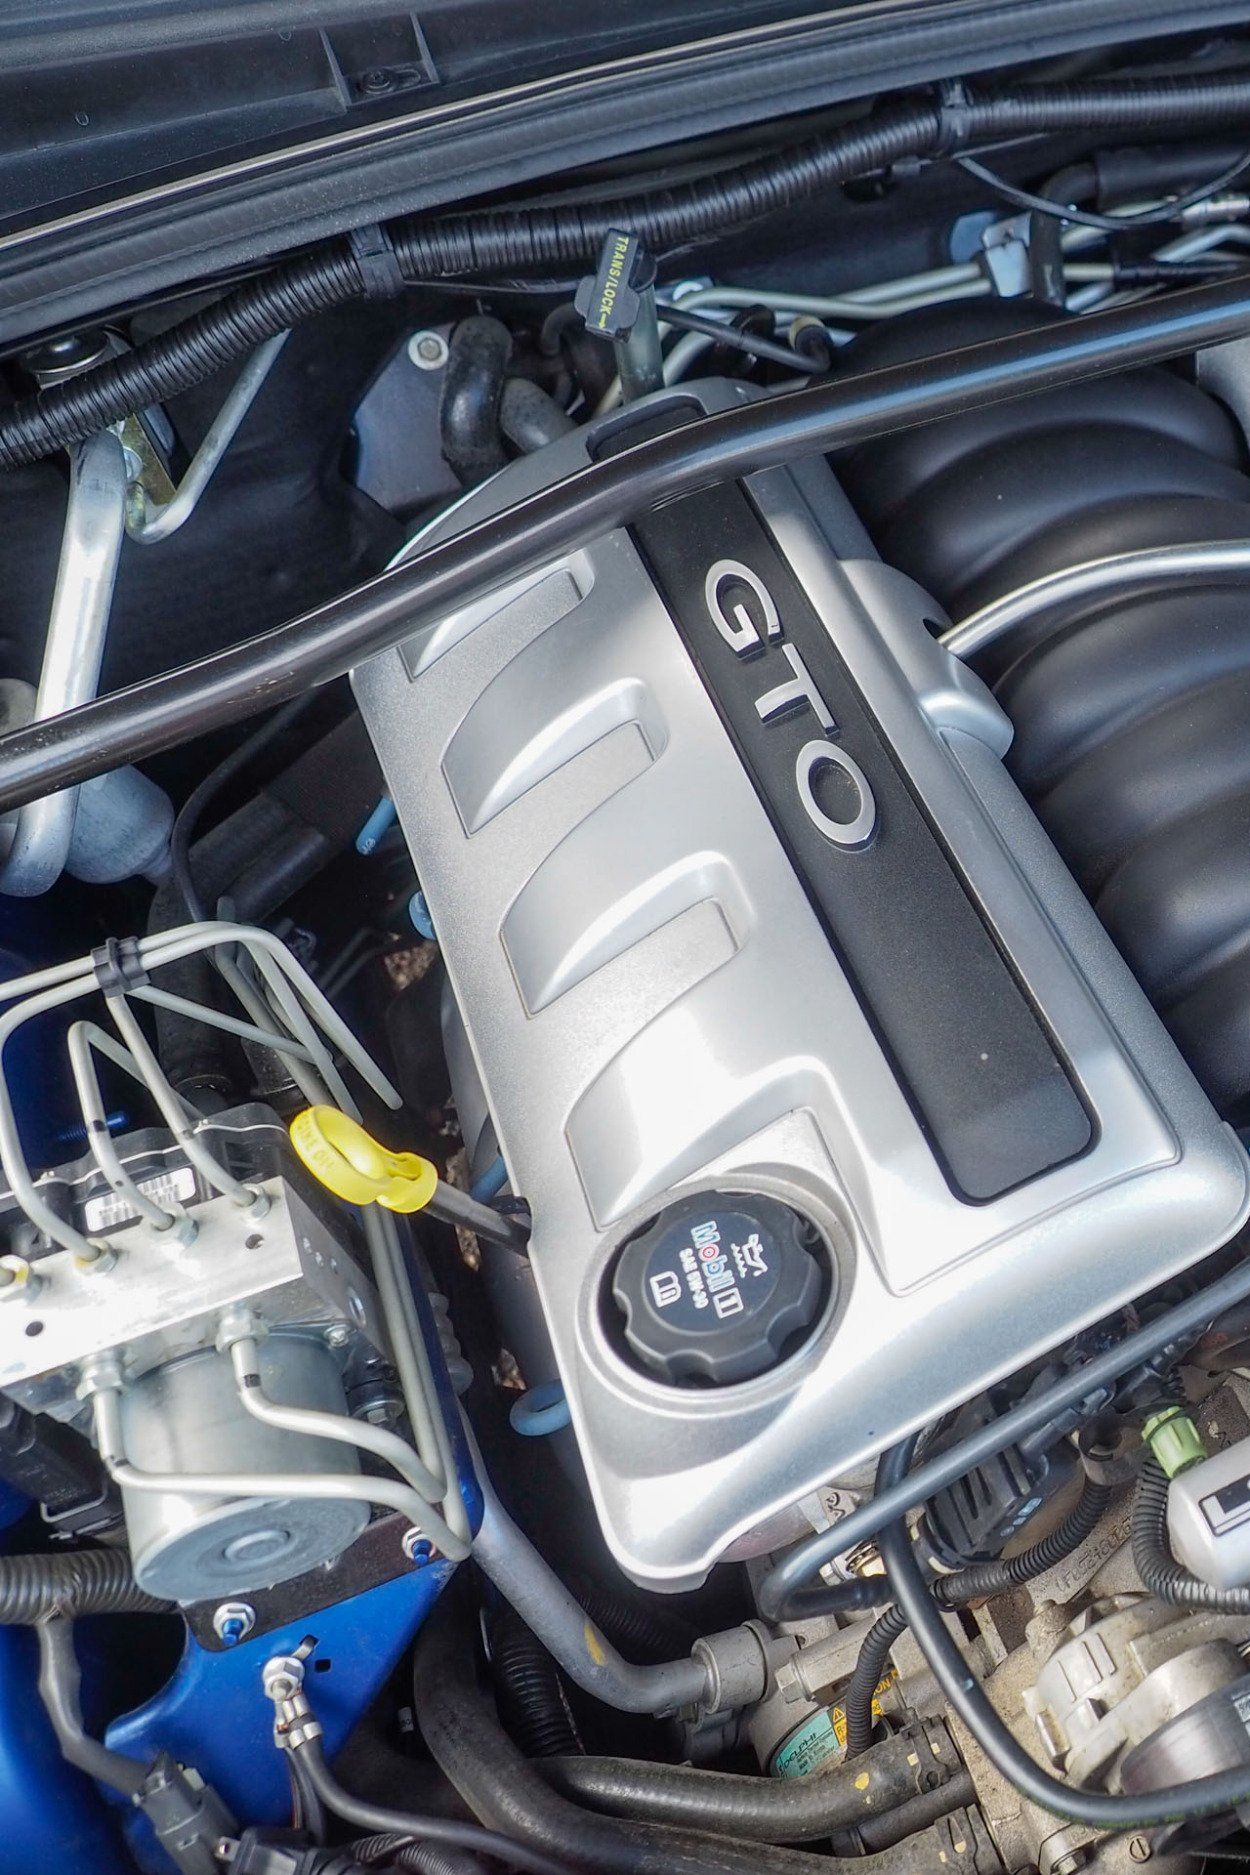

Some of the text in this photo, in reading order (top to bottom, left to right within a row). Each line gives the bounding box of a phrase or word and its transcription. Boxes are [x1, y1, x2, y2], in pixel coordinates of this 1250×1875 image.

[600, 236, 629, 316] TRANS/LOCK
[705, 559, 877, 850] GTO
[691, 1221, 735, 1293] Mobil
[783, 1732, 817, 1770] DELPHI
